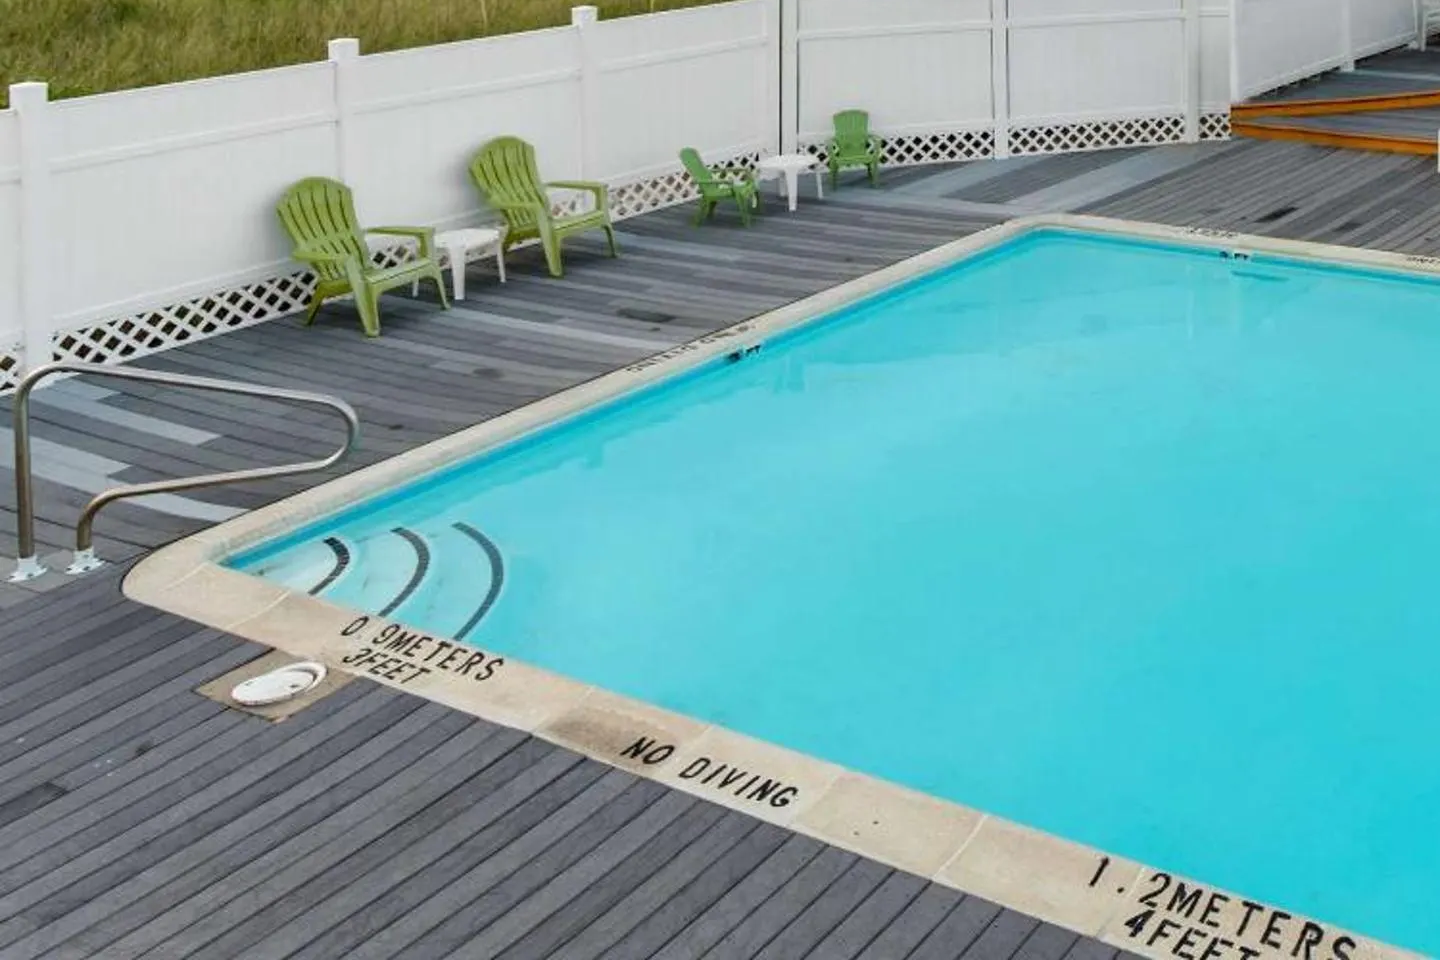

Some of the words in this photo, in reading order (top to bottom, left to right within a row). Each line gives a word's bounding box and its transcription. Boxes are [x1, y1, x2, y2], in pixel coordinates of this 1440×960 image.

[342, 648, 431, 684] 3FEET
[619, 735, 676, 765] NO
[678, 756, 799, 808] DIVING
